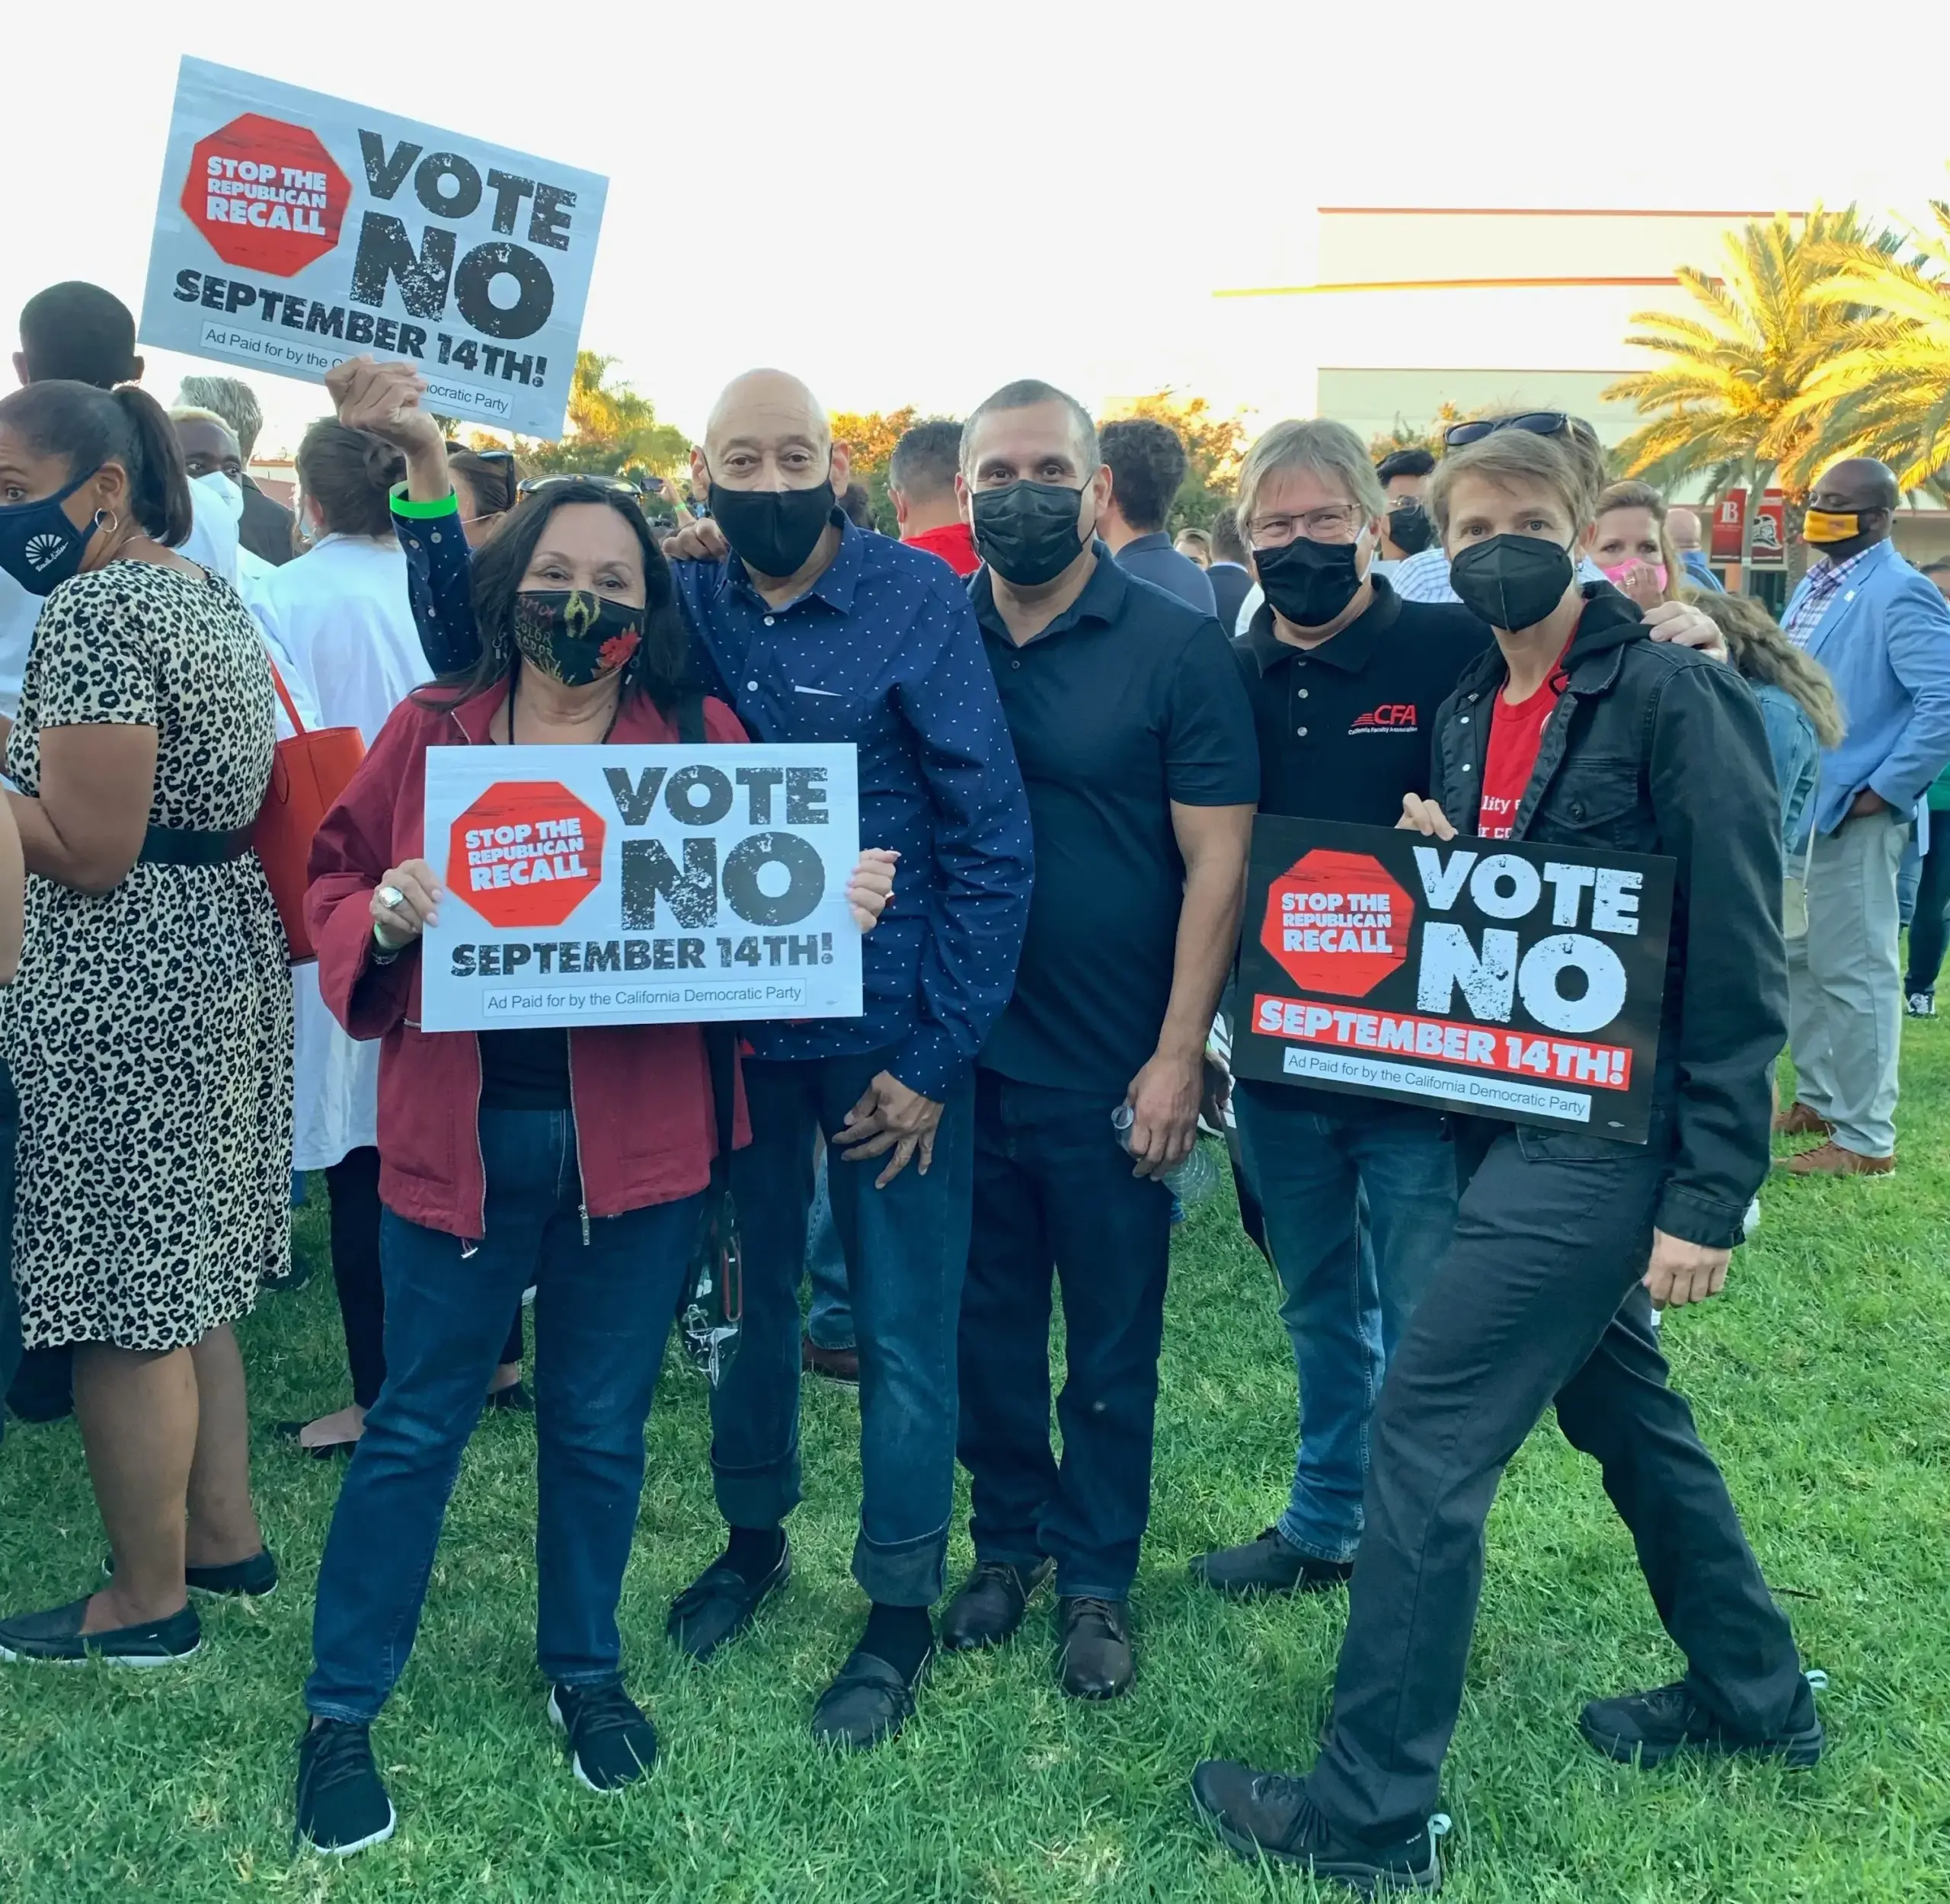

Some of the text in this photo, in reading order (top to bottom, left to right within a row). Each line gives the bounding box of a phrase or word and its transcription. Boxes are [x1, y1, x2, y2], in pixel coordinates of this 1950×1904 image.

[207, 156, 327, 192] STOP THE
[357, 128, 577, 251] VOTE
[207, 178, 326, 208] REPUBLICAN
[206, 196, 325, 235] RECALL
[350, 210, 555, 340] NO
[173, 269, 548, 389] SEPTEMBER 14TH!
[206, 329, 225, 344] Ad
[229, 334, 261, 352] Paid
[264, 342, 283, 357] for
[286, 347, 304, 364] by
[307, 354, 328, 367] the
[475, 392, 508, 414] Party
[1374, 704, 1416, 725] CFA
[603, 764, 830, 827] VOTE
[1482, 795, 1511, 814] lity
[465, 818, 582, 849] STOP THE
[1478, 824, 1490, 838] ir
[468, 837, 584, 866] REPUBLICAN
[470, 854, 588, 891] RECALL
[620, 830, 826, 931] NO
[1412, 846, 1643, 935] VOTE
[1281, 892, 1391, 912] STOP THE
[1282, 913, 1392, 928] REPUBLICAN
[450, 932, 835, 977] SEPTEMBER 14TH!
[1283, 929, 1393, 953] RECALL
[1417, 921, 1627, 1033] NO
[488, 986, 801, 1009] Ad Paid for by the California Democratic Party
[1258, 1000, 1626, 1085] SEPTEMBER 14TH!
[1288, 1054, 1586, 1116] Ad Paid for by the California Democratic Party
